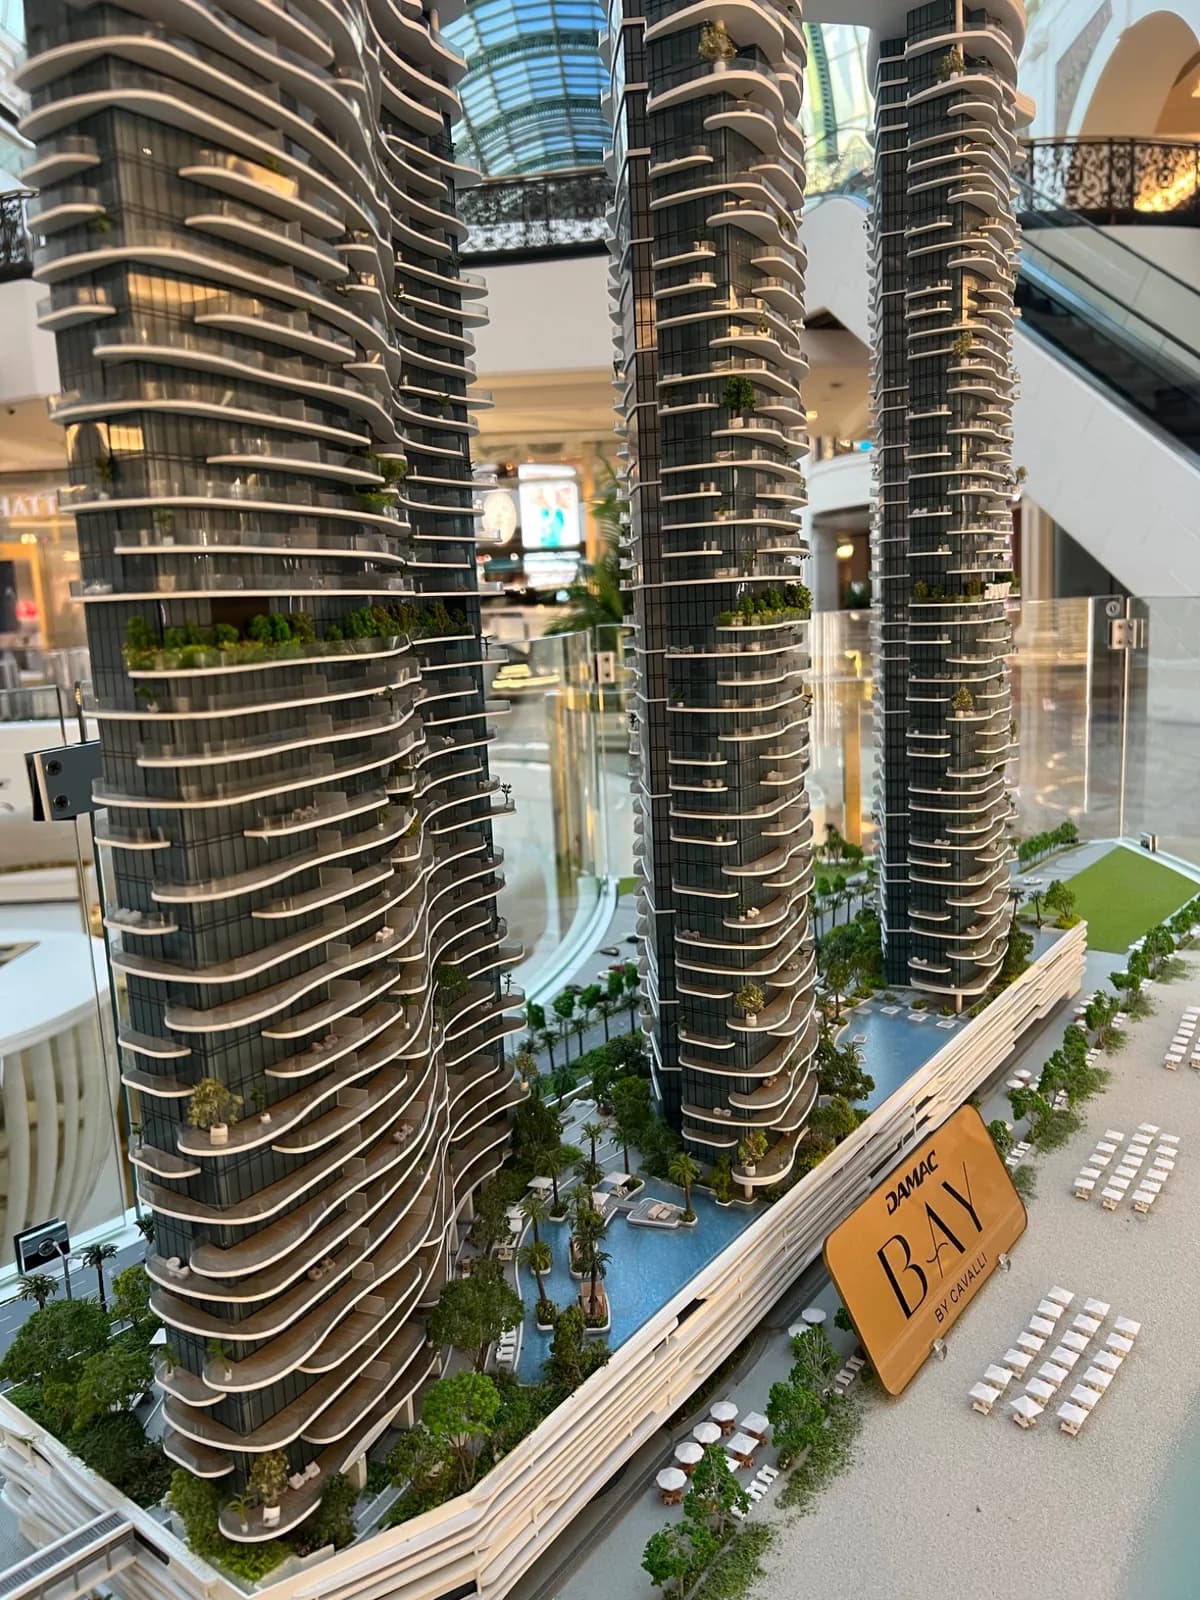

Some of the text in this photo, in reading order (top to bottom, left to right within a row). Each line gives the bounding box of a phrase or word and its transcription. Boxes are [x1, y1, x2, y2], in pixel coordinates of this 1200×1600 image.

[885, 1149, 938, 1216] DAMAC
[877, 1161, 983, 1320] BAY
[934, 1251, 988, 1323] BY CAVALLI
